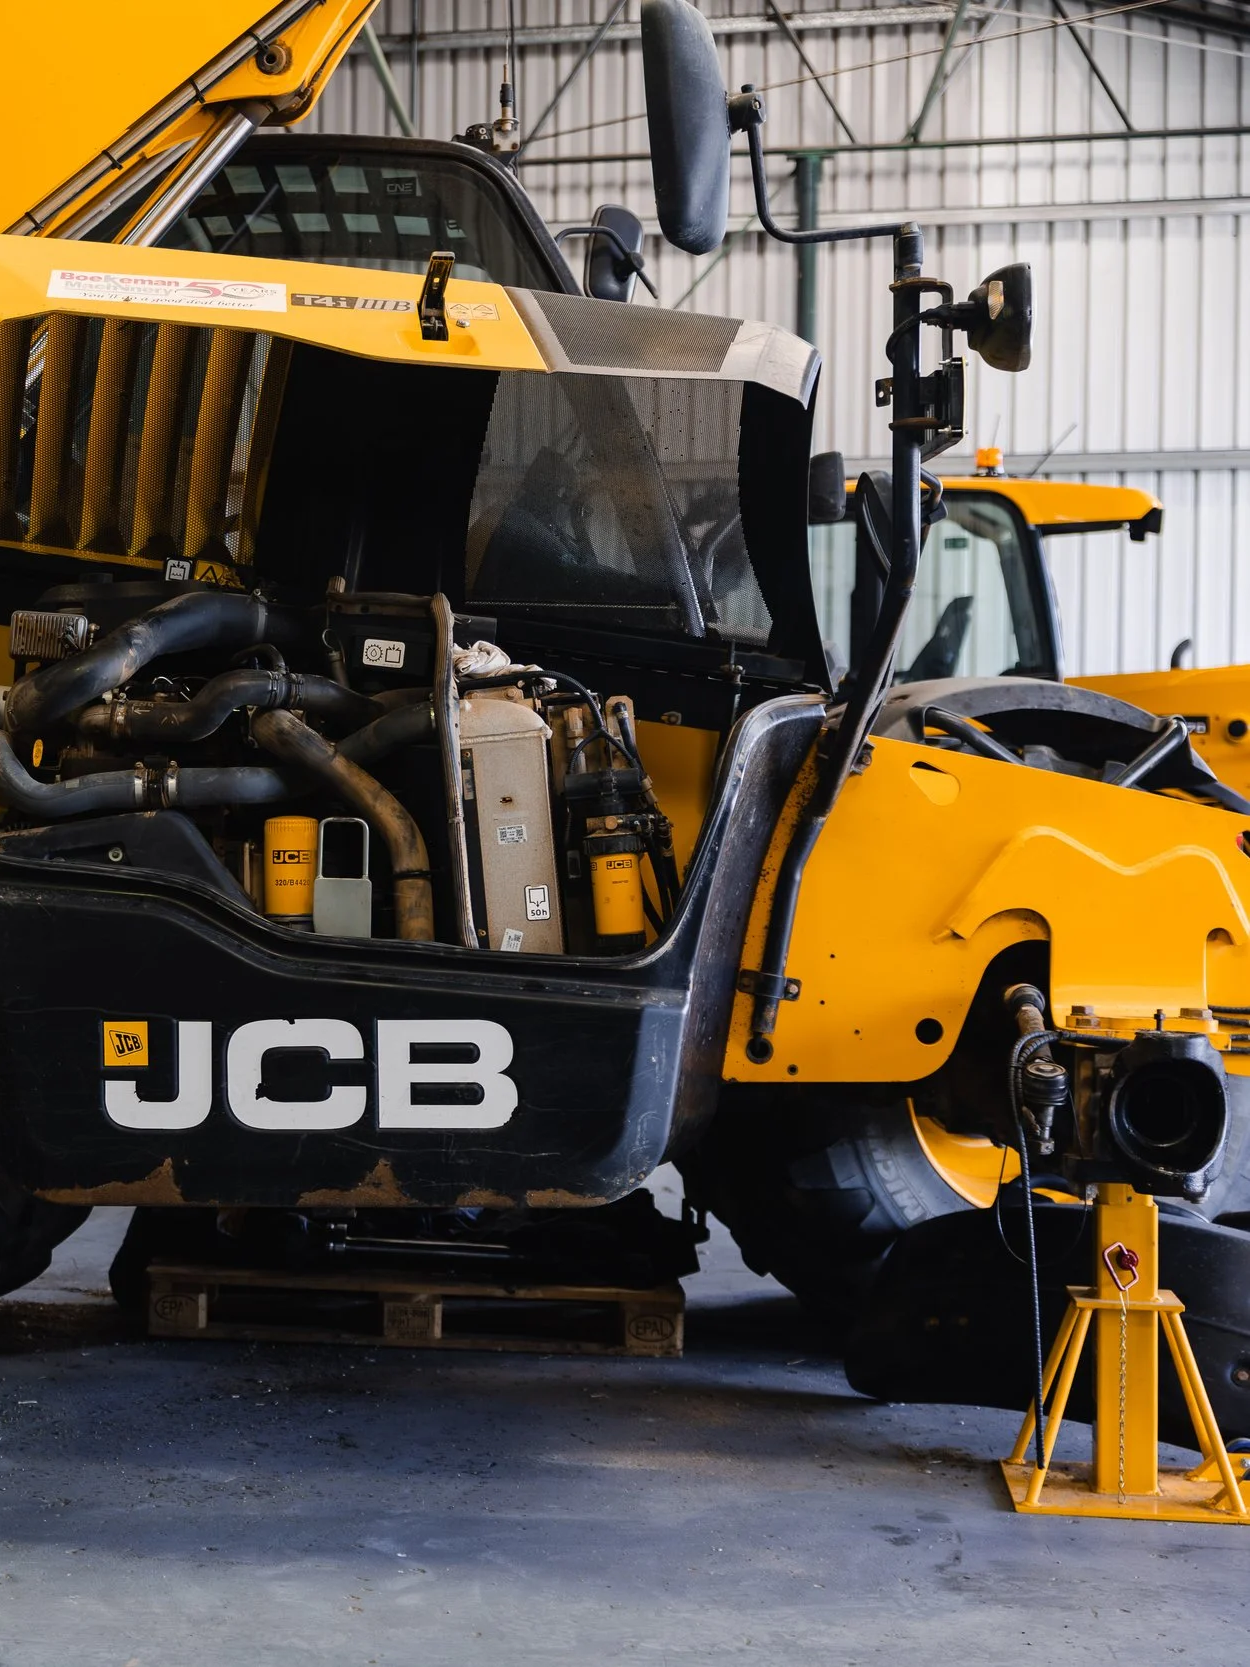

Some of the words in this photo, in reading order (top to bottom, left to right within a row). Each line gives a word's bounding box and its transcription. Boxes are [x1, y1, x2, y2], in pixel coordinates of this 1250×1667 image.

[295, 294, 351, 308] T4i
[273, 850, 312, 864] JCB
[607, 860, 632, 869] JCB
[116, 1033, 142, 1055] JCB
[103, 1019, 519, 1130] JCB
